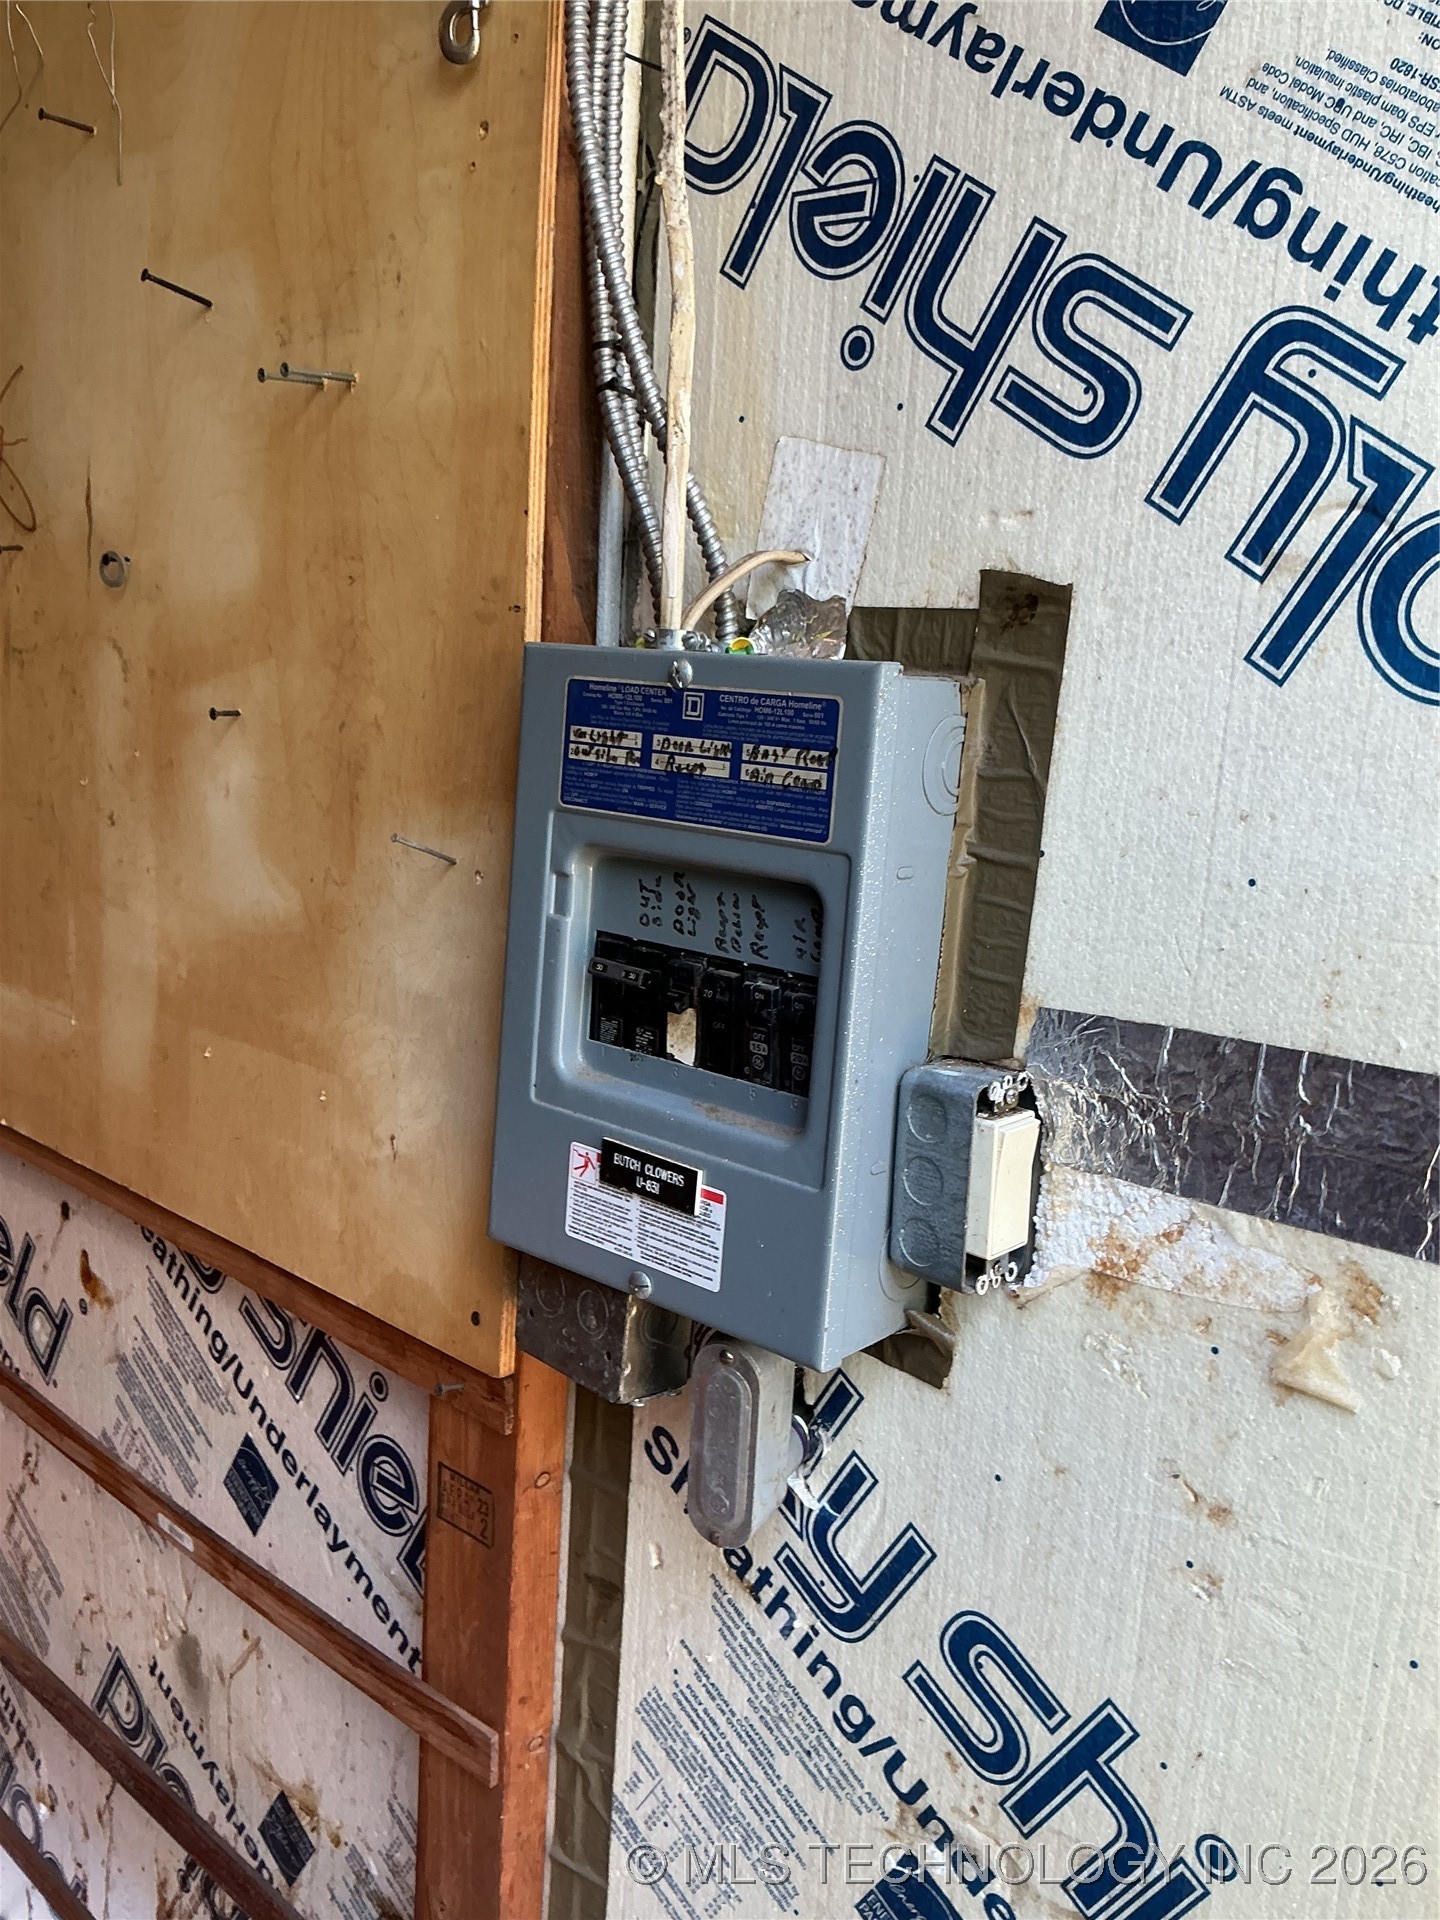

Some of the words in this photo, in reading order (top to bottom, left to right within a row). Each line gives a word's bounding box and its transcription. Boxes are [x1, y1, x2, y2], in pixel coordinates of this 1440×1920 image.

[1260, 61, 1290, 84] Code
[1290, 54, 1345, 91] insulation.
[1322, 46, 1380, 85] Classified.
[1218, 84, 1257, 113] ASTM
[1245, 76, 1270, 97] and
[1287, 75, 1325, 103] Model
[1342, 78, 1382, 109] plastic
[1255, 103, 1294, 132] meets
[1266, 86, 1342, 135] Specification,
[1351, 109, 1377, 131] and
[1378, 99, 1409, 124] foam
[1340, 126, 1371, 151] HUD
[1376, 120, 1406, 145] IRC,
[1407, 114, 1436, 137] EPS
[1369, 140, 1408, 170] C578,
[1404, 135, 1434, 160] IBC,
[640, 687, 666, 696] CENTER
[719, 694, 749, 703] CENTRO
[760, 697, 786, 707] CARGA
[613, 1152, 641, 1172] BUTCH
[644, 1163, 684, 1187] CLOWERS
[708, 1573, 728, 1597] POLY
[864, 1789, 890, 1822] ASTM
[793, 1721, 809, 1740] and
[823, 1762, 846, 1791] Model
[844, 1790, 864, 1816] Code
[797, 1710, 816, 1734] HUD
[856, 1794, 872, 1813] and
